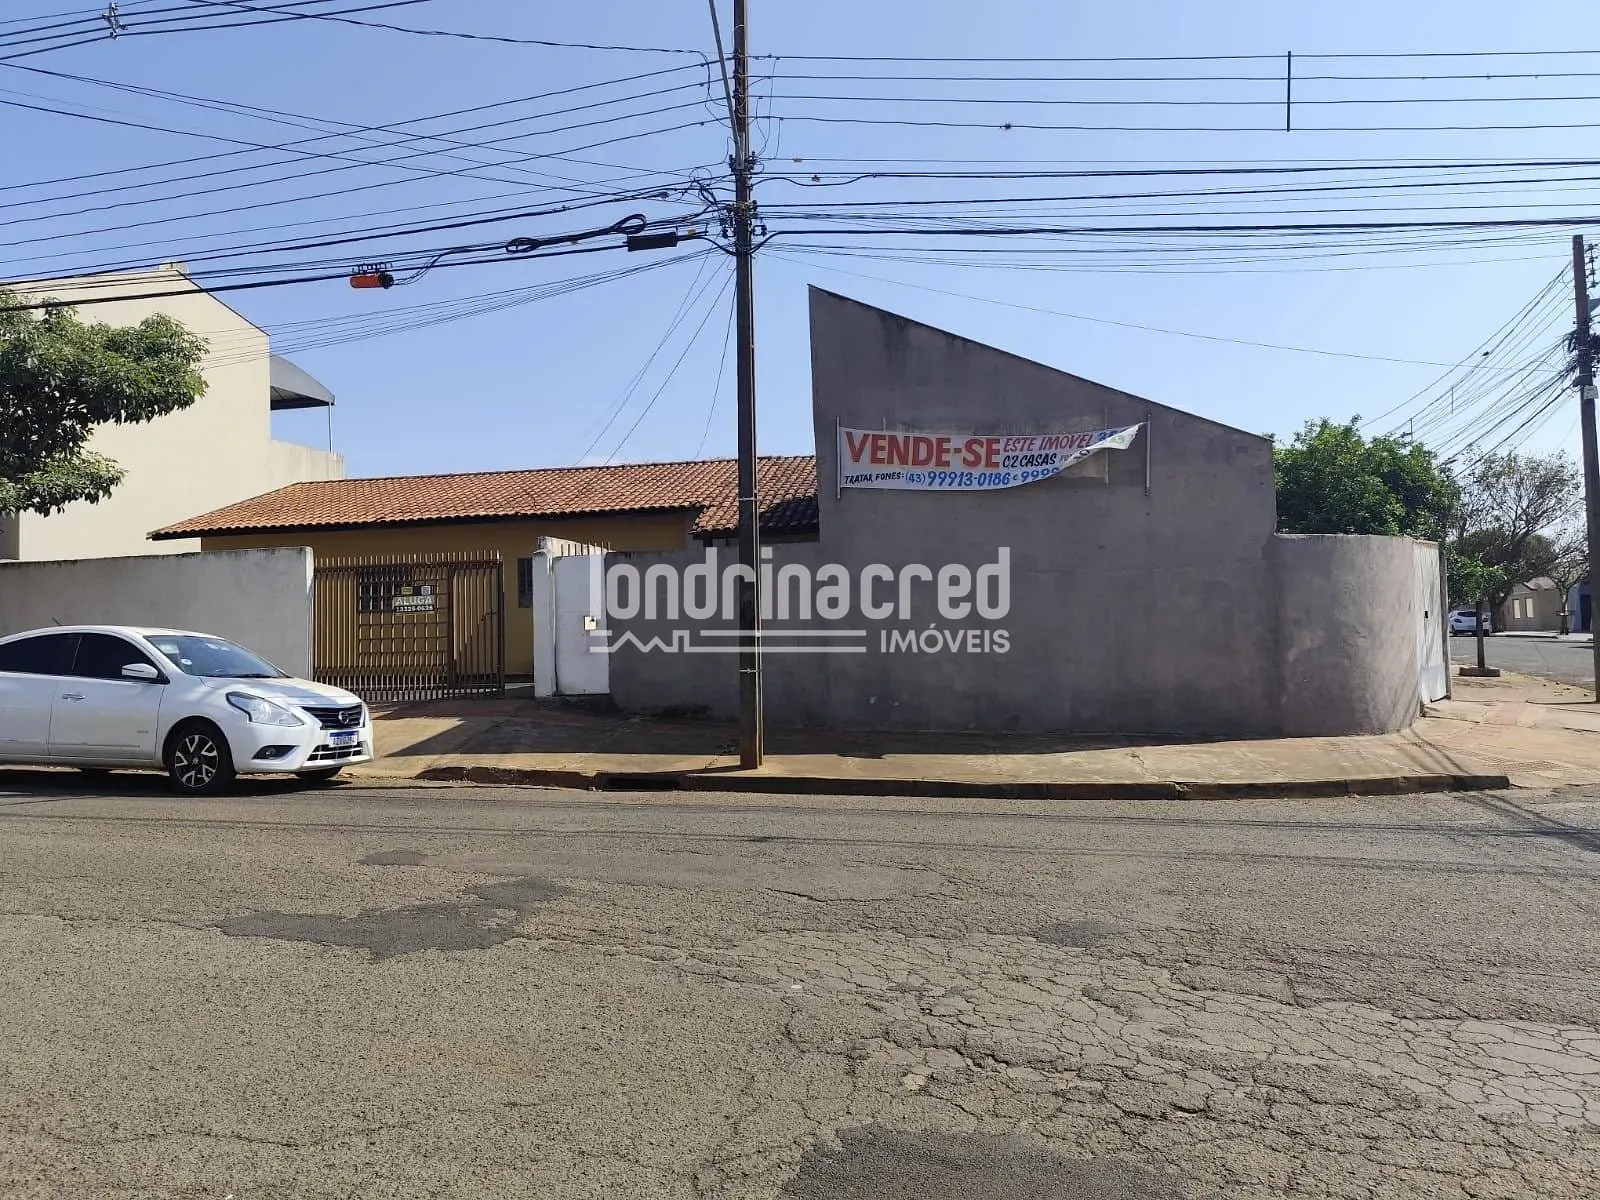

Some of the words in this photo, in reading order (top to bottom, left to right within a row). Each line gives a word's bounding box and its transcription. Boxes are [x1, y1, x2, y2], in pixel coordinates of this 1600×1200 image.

[845, 431, 1001, 468] VENDE-SE
[1003, 438, 1036, 452] ESTE
[1020, 453, 1057, 467] CASAS
[844, 473, 873, 484] TRATAR
[875, 471, 904, 481] FONES:
[395, 596, 432, 605] ALUGA
